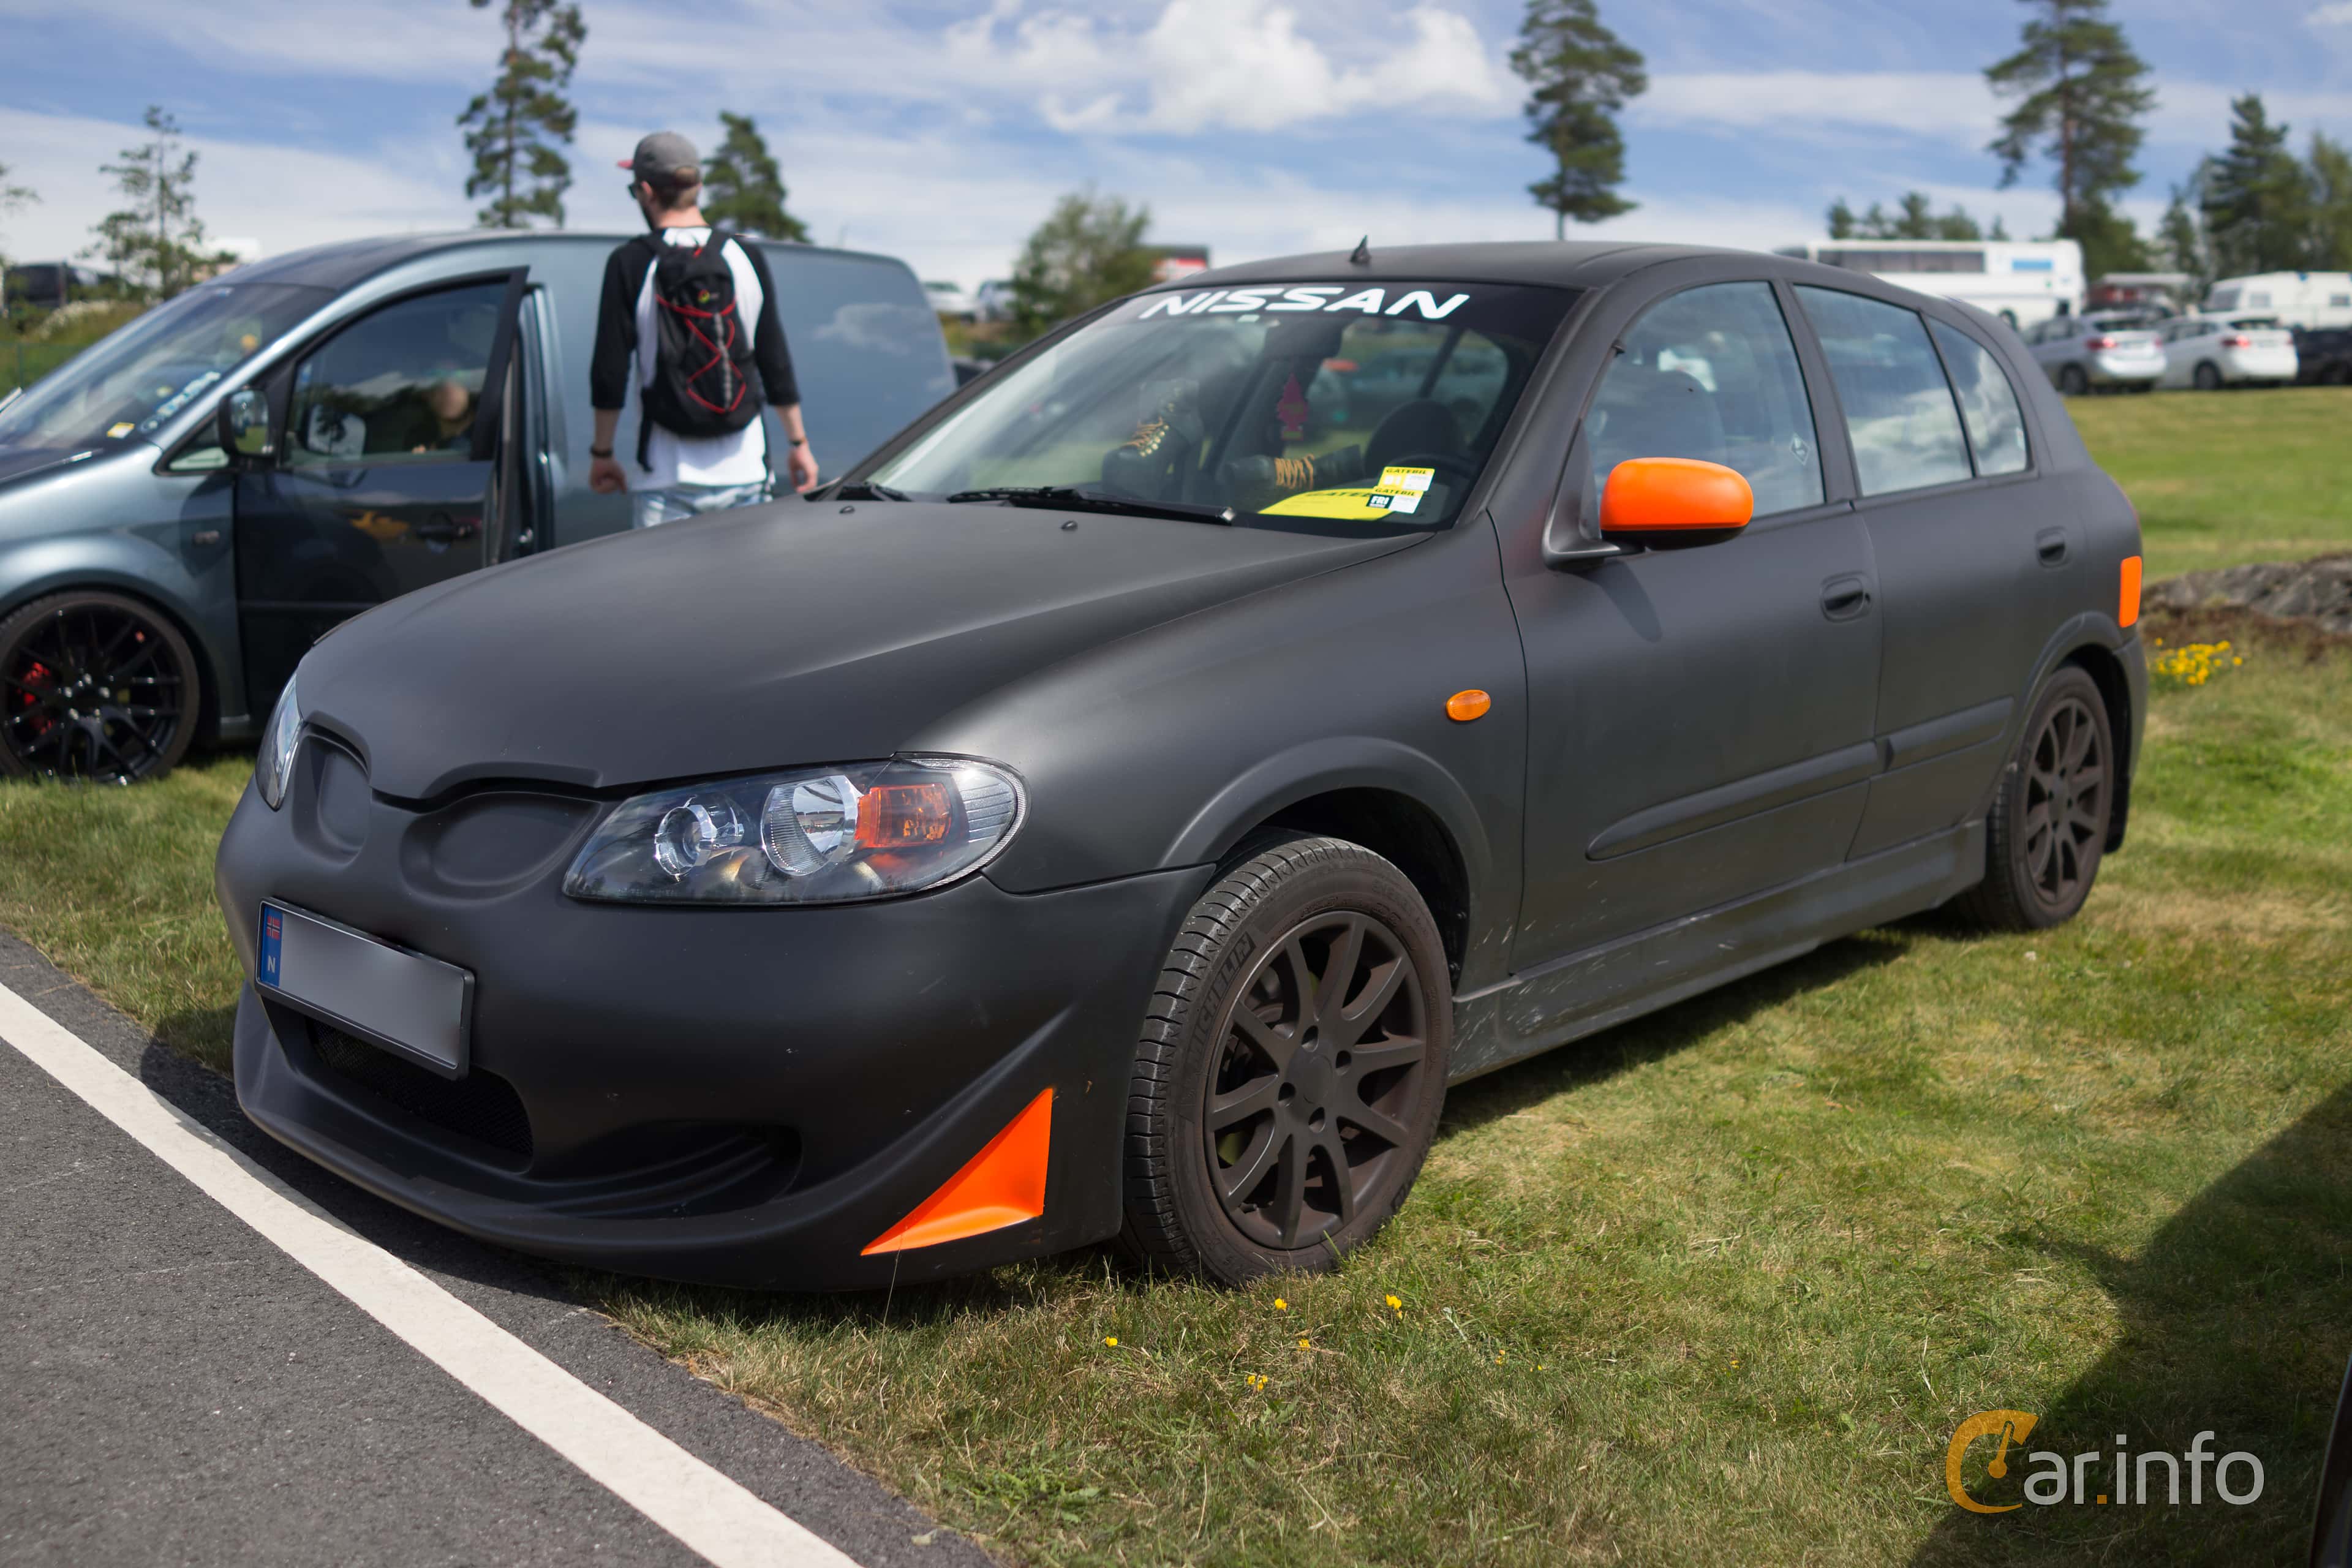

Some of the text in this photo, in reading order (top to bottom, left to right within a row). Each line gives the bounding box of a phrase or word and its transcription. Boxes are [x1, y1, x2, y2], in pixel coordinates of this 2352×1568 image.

[1139, 287, 1470, 320] NISSAN
[1374, 488, 1415, 496] GATEBIL
[1370, 496, 1390, 504] FRI
[267, 955, 276, 973] N
